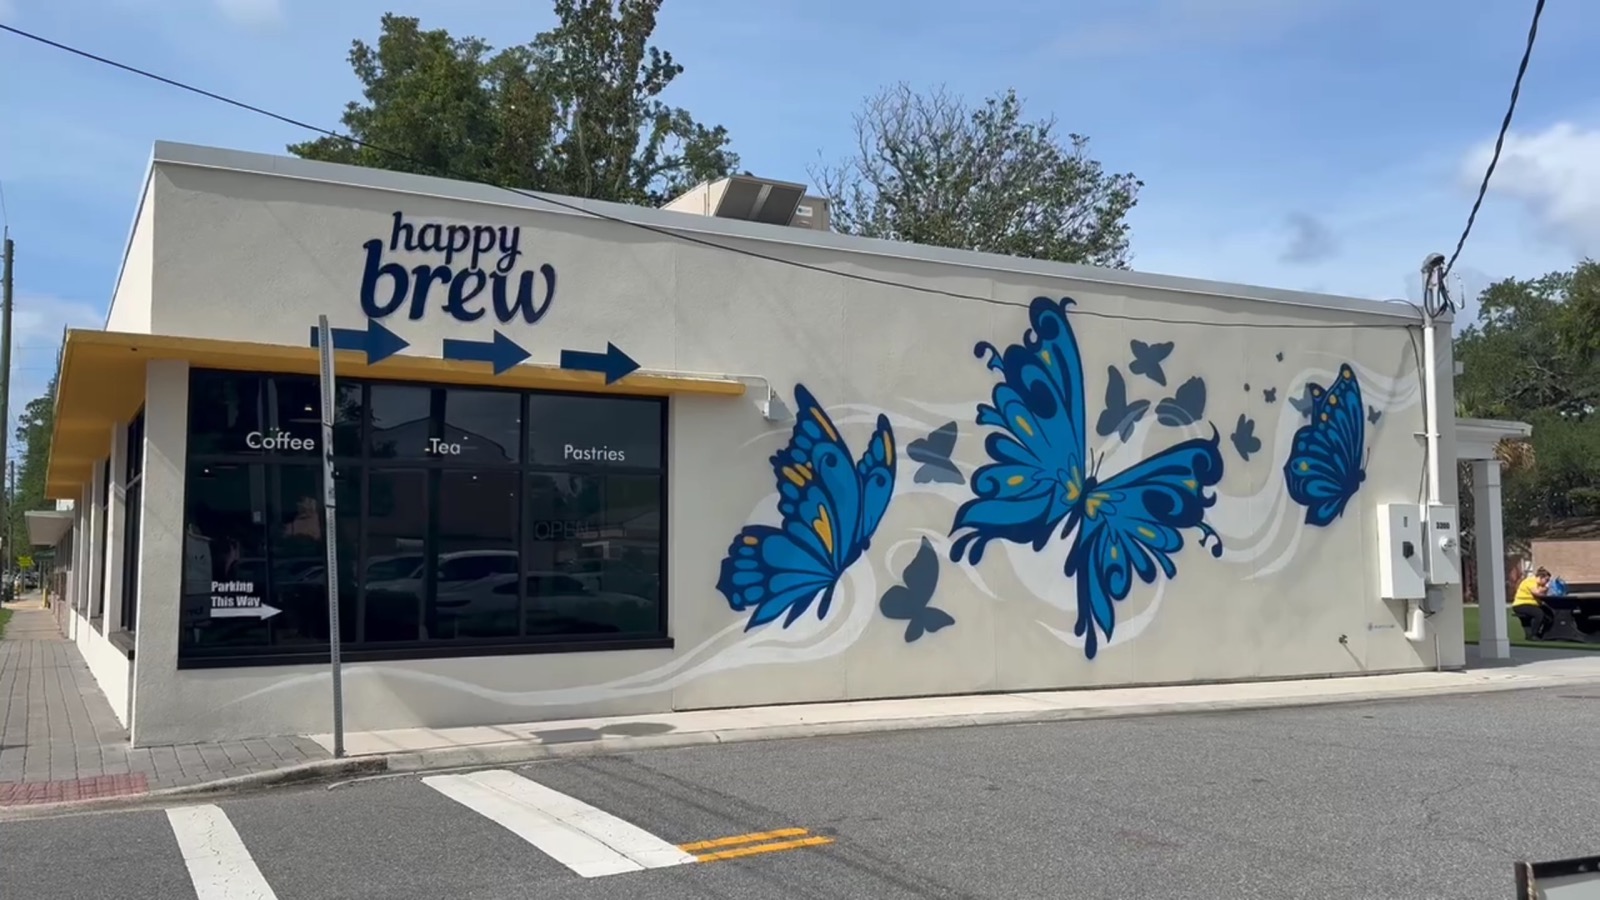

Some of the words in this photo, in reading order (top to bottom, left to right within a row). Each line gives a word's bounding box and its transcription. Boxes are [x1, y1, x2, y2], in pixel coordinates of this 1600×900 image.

[390, 211, 522, 273] happy
[360, 239, 555, 323] brew
[246, 432, 315, 450] Coffee
[429, 438, 460, 454] Tea
[564, 444, 625, 461] Pastries
[535, 520, 588, 539] OPEN
[211, 581, 254, 593] Parking
[210, 596, 234, 607] This
[236, 595, 260, 607] Way
